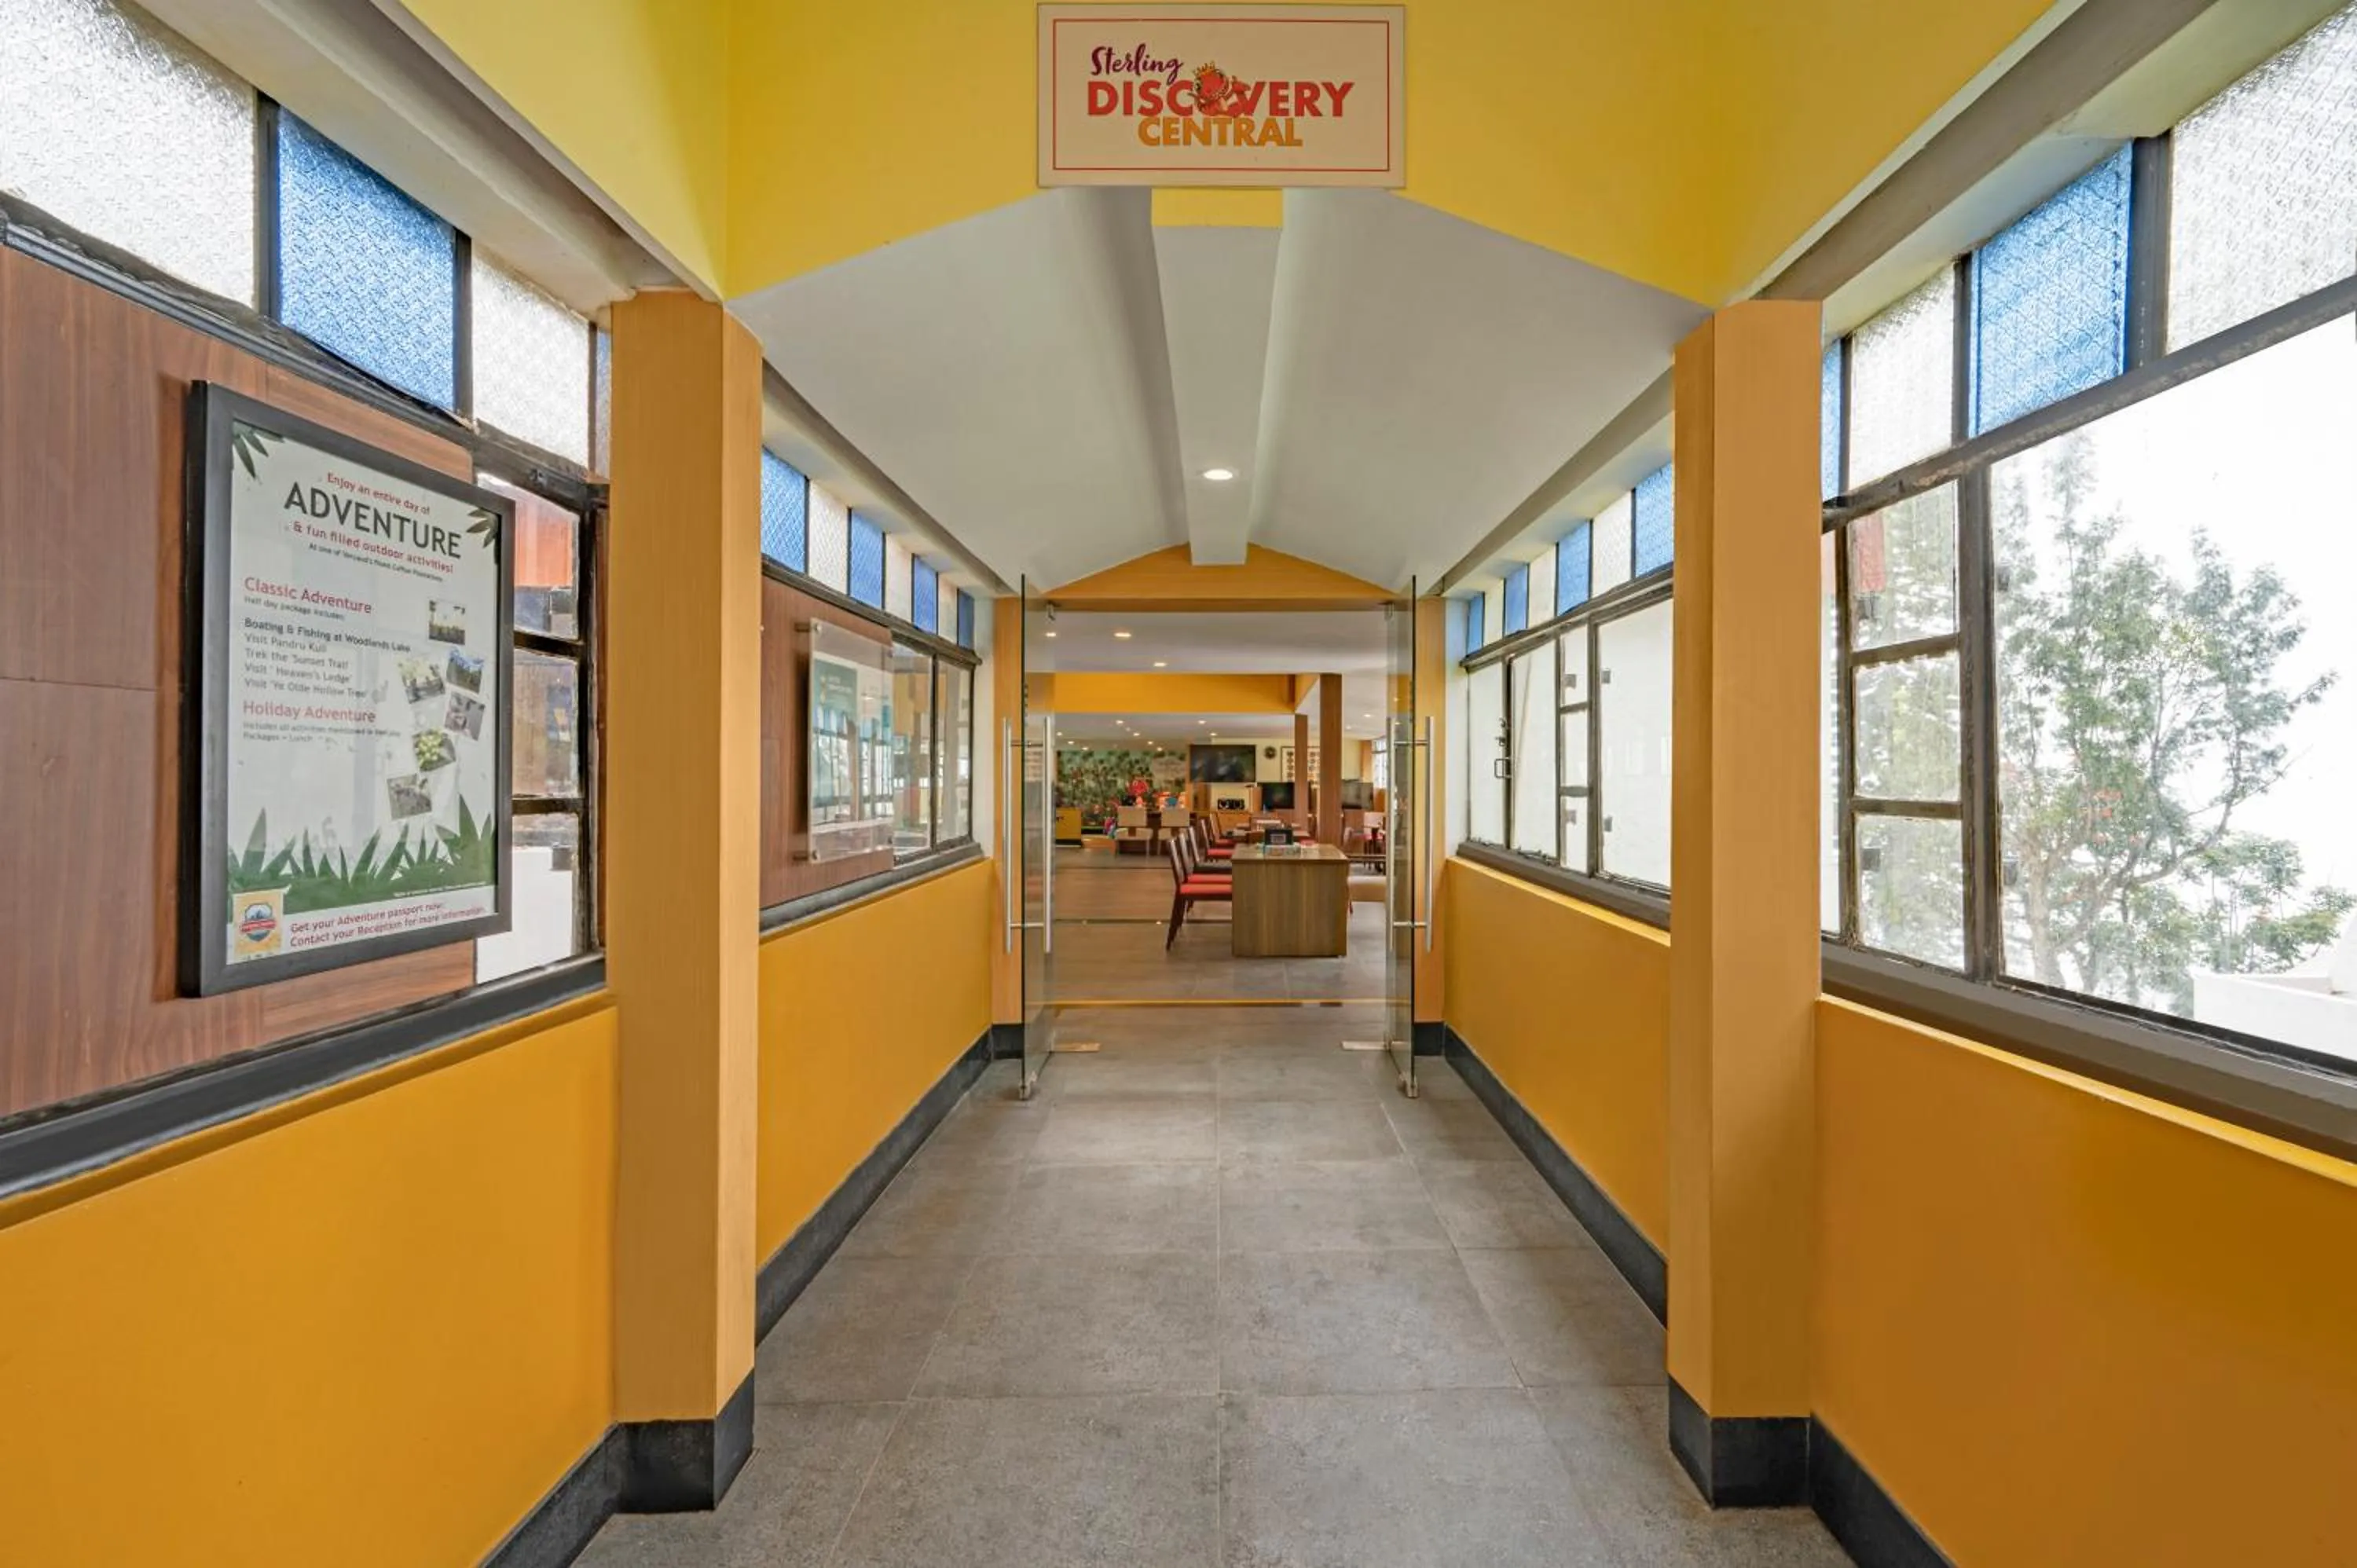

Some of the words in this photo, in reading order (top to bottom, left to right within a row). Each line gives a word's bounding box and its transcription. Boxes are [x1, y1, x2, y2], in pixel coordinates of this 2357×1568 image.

[1091, 43, 1183, 85] Sterling
[1087, 80, 1354, 117] DISCVERY
[1138, 117, 1303, 147] CENTRAL
[328, 473, 355, 492] Enjoy
[358, 485, 370, 496] an
[373, 490, 401, 505] entire
[403, 500, 420, 512] day
[420, 506, 431, 515] of
[284, 482, 462, 559] ADVENTURE
[293, 521, 302, 533] &
[306, 526, 326, 539] fun
[330, 531, 360, 549] filled
[362, 541, 404, 559] outdoor
[407, 554, 454, 574] activities!
[244, 577, 297, 599] Classic
[301, 588, 372, 614] Adventure
[263, 599, 278, 610] day
[280, 603, 311, 615] package
[244, 617, 284, 635] Boating
[288, 625, 294, 634] &
[297, 626, 331, 642] Fishing
[334, 633, 342, 642] at
[345, 634, 390, 650] Woodlands
[391, 642, 411, 653] Lake
[244, 633, 268, 645] Visit
[244, 648, 267, 659] Trek
[272, 651, 288, 662] the
[244, 663, 267, 674] Visit
[244, 678, 267, 690] Visit
[244, 700, 301, 720] Holiday
[304, 705, 376, 724] Adventure
[290, 922, 310, 934] Get
[311, 919, 335, 931] your
[337, 911, 386, 927] Adventure
[387, 904, 423, 920] passport
[290, 932, 331, 947] Contact
[332, 929, 355, 941] your
[357, 921, 403, 936] Reception
[405, 917, 417, 928] for
[418, 914, 440, 924] more
